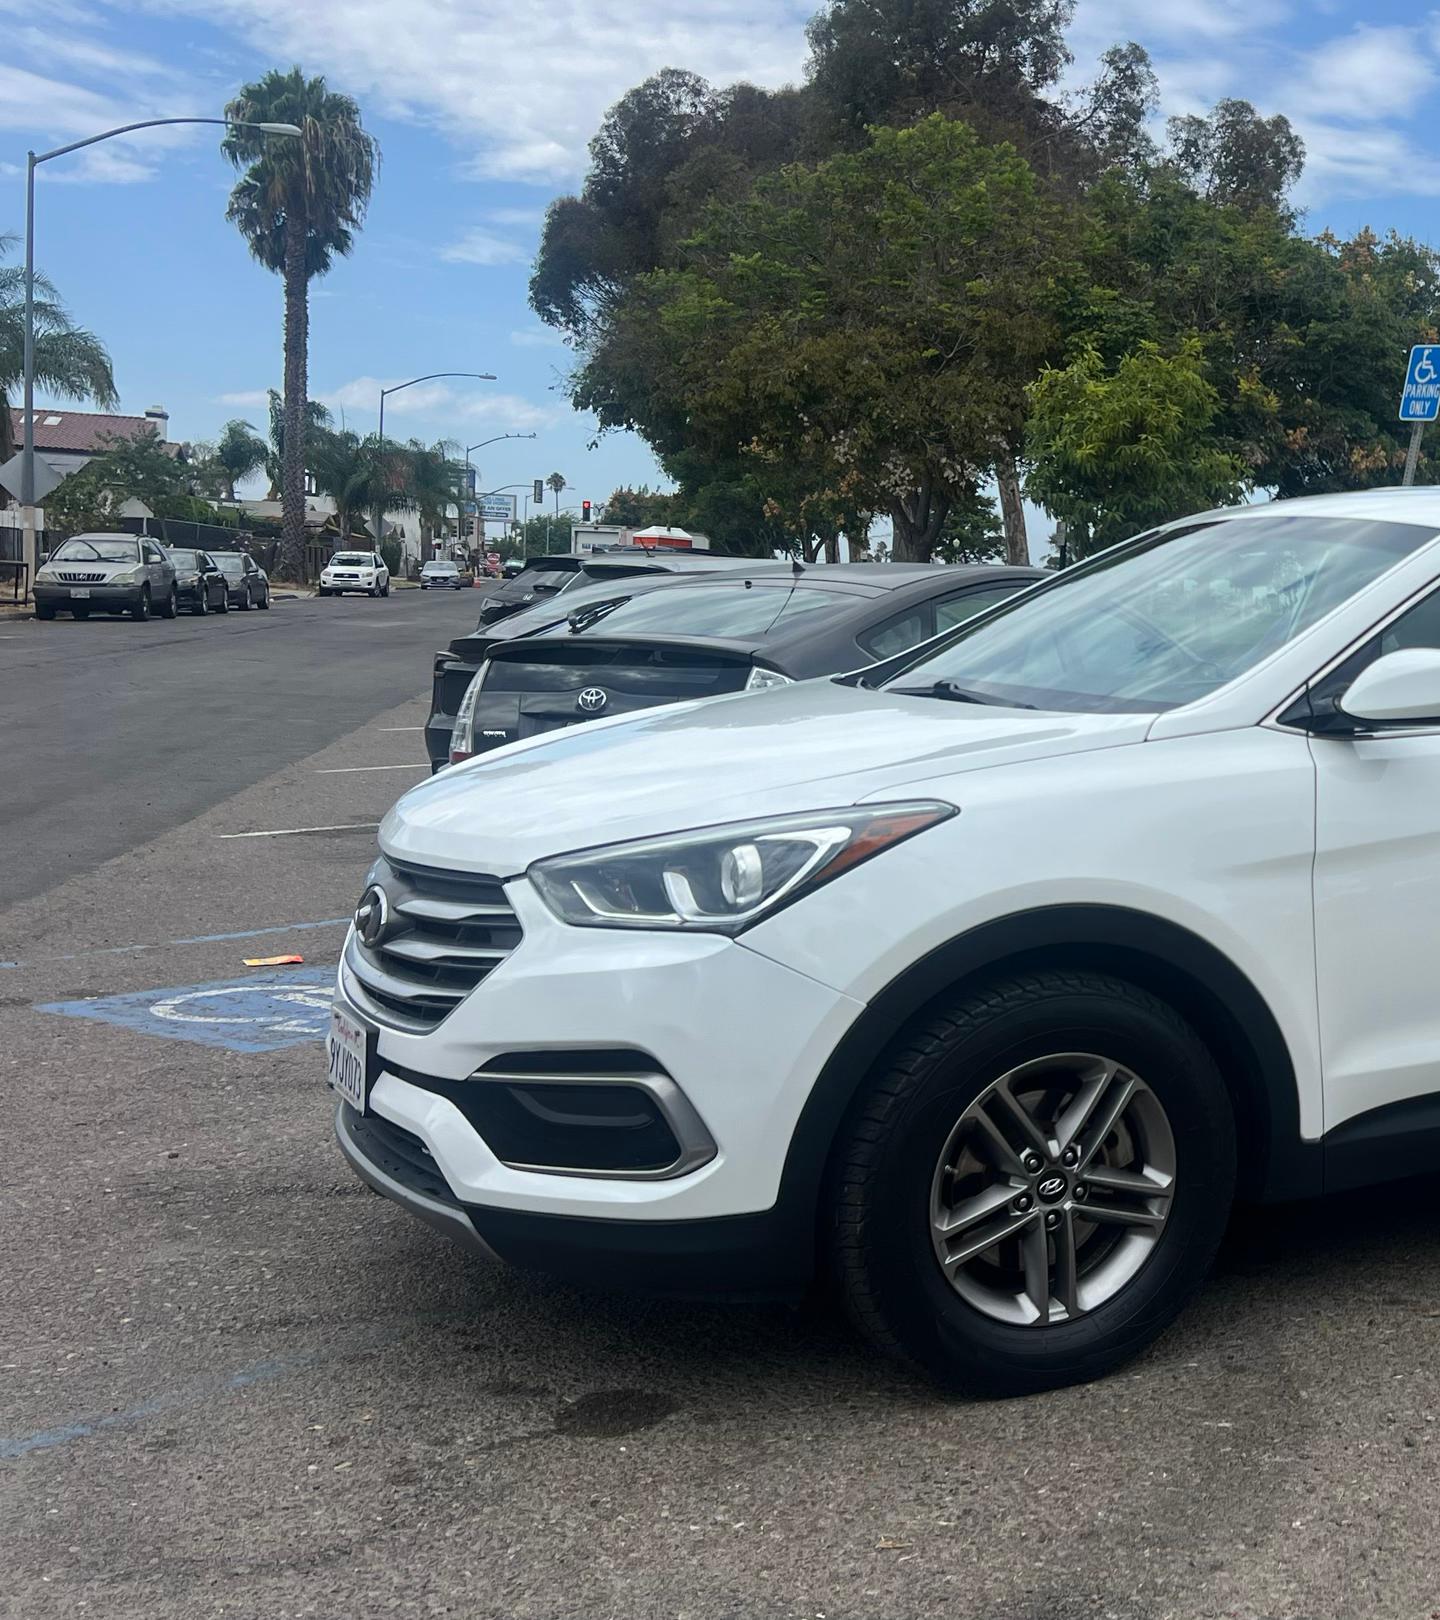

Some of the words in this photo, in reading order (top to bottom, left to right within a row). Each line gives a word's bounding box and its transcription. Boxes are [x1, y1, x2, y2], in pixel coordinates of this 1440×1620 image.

[1405, 384, 1440, 398] PARKING
[1409, 400, 1431, 416] ONLY
[329, 1037, 362, 1100] 9YJY073
